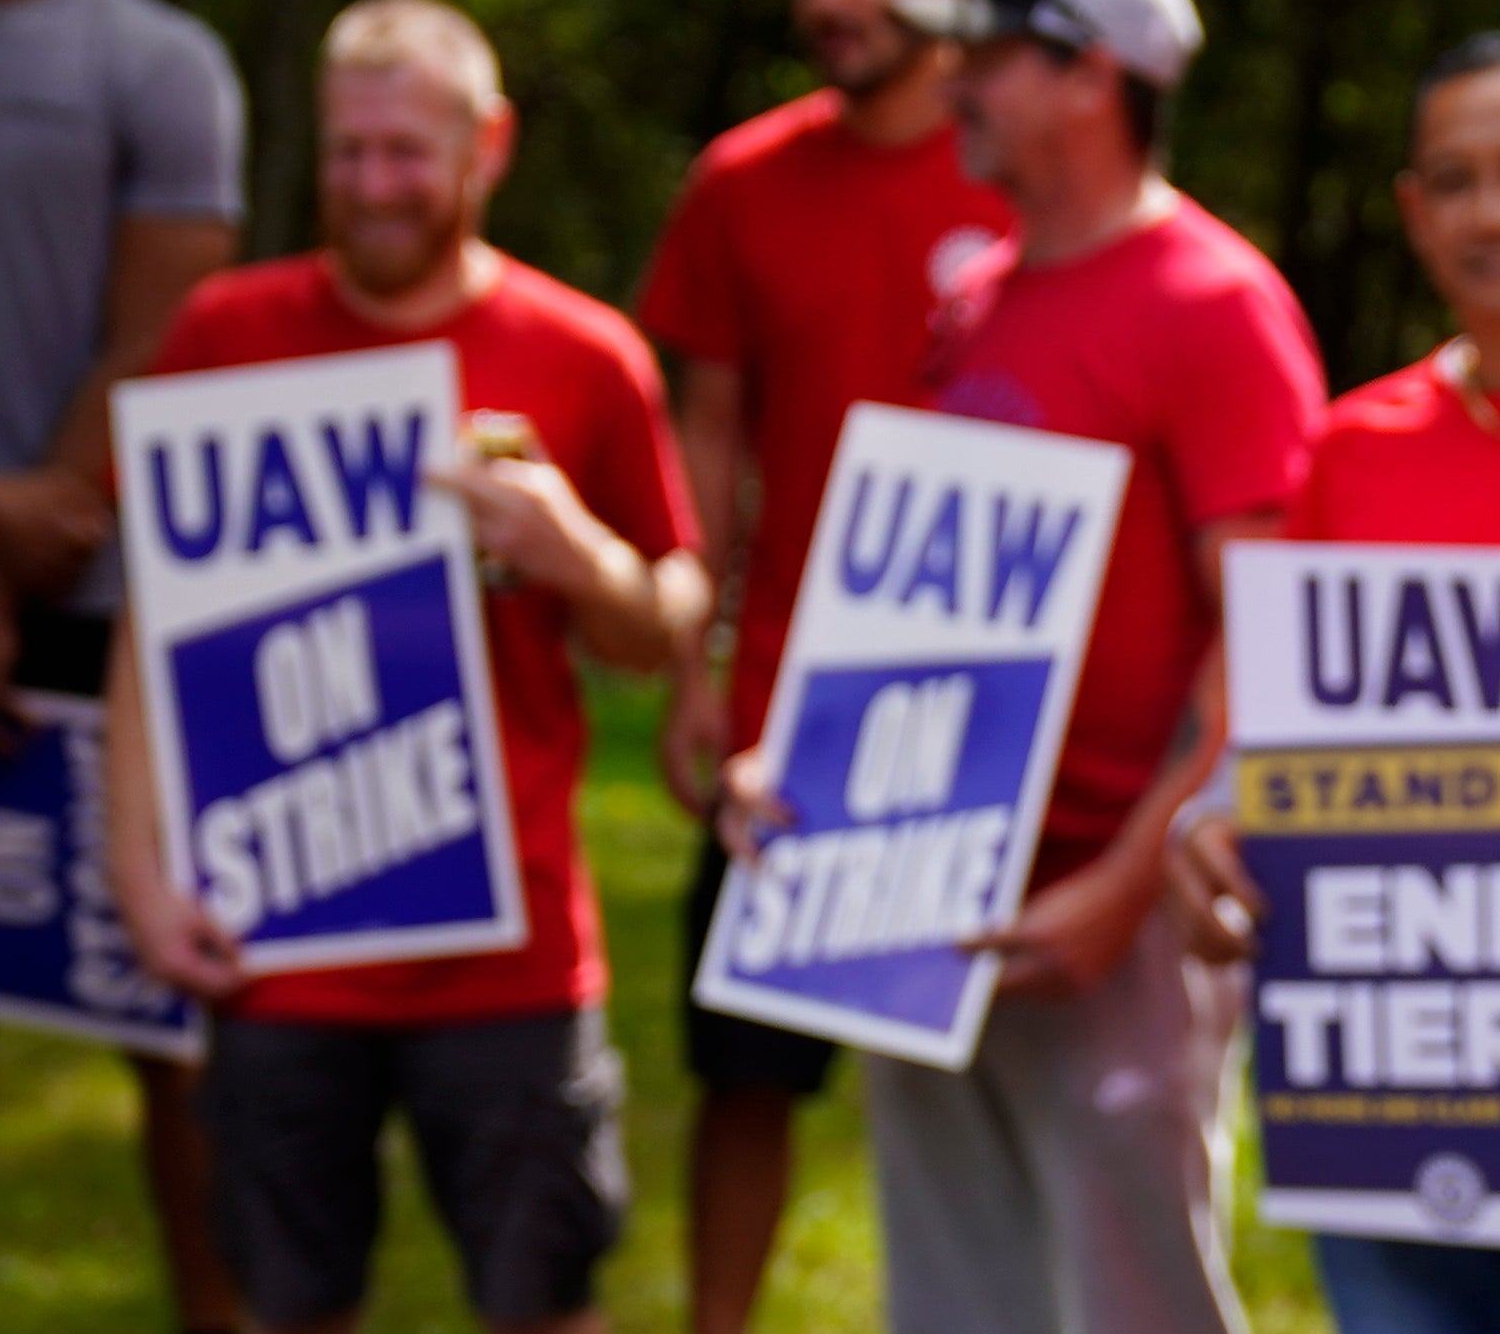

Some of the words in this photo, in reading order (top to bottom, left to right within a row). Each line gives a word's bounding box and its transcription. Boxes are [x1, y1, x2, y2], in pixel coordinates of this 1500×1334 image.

[148, 406, 428, 560] UAW
[837, 467, 1087, 628] UAW
[253, 597, 380, 764] ON
[843, 675, 975, 820] ON
[199, 698, 476, 932] STRIKE
[1266, 766, 1498, 812] STAND
[736, 804, 1014, 972] STRIKE
